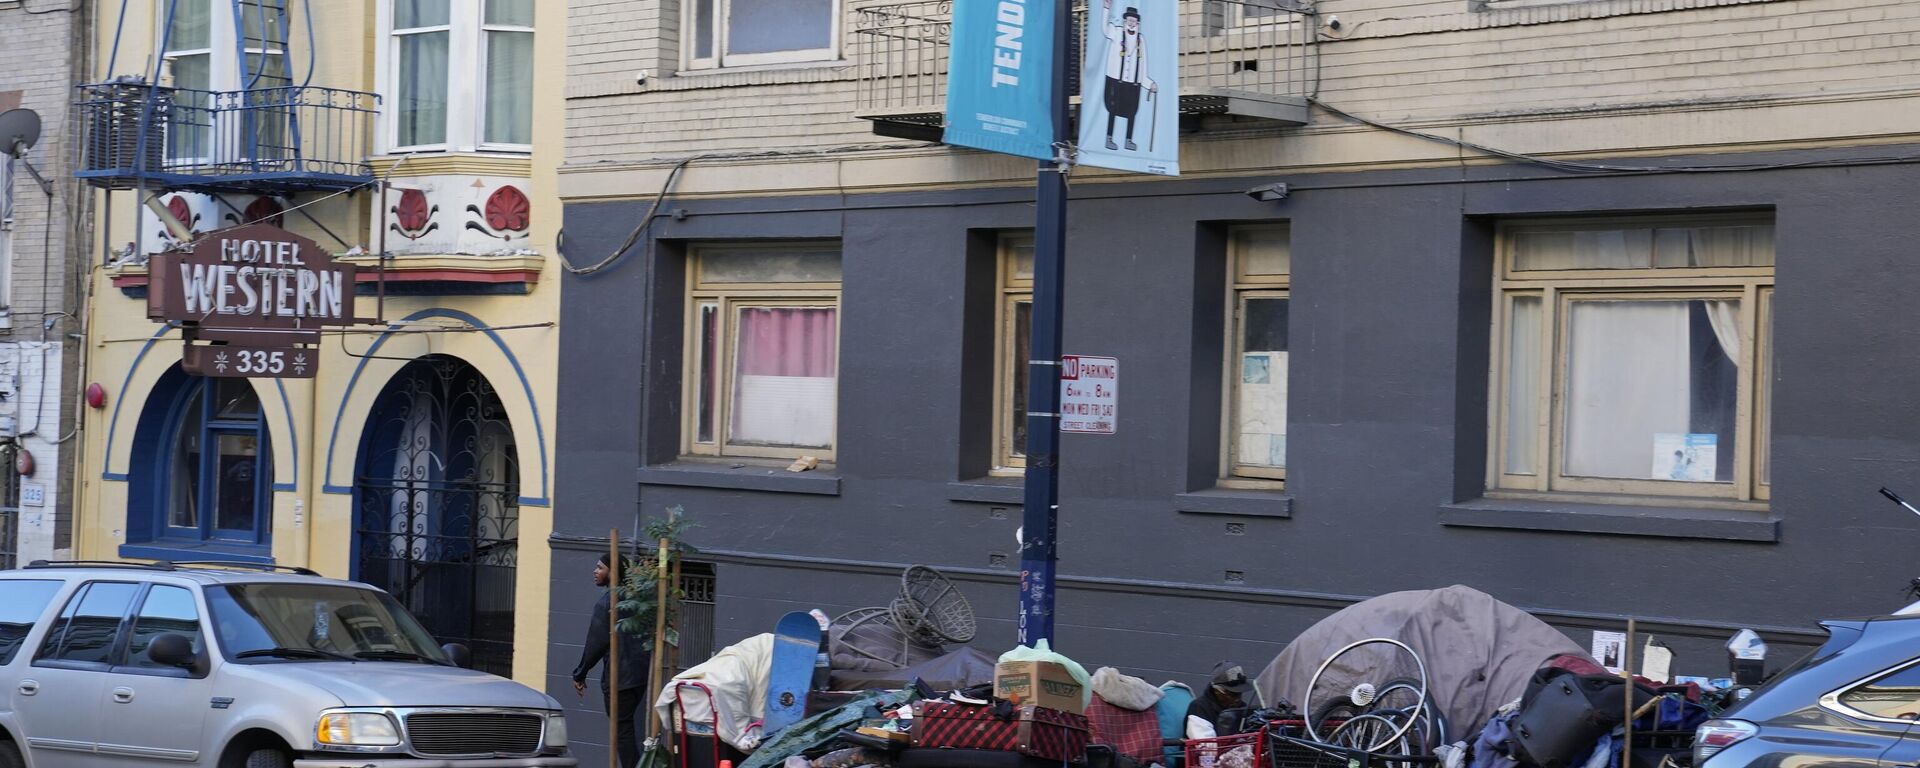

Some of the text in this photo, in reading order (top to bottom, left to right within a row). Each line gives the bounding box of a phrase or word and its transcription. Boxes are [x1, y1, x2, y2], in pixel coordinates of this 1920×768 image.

[992, 0, 1026, 88] TEND
[221, 238, 305, 265] HOTEL
[180, 262, 342, 318] WESTERN
[235, 350, 285, 374] 335
[1062, 358, 1115, 379] NO PARKING
[1063, 402, 1113, 416] MON WED FRI SAT
[1063, 421, 1084, 429] STREET
[24, 488, 41, 501] 325
